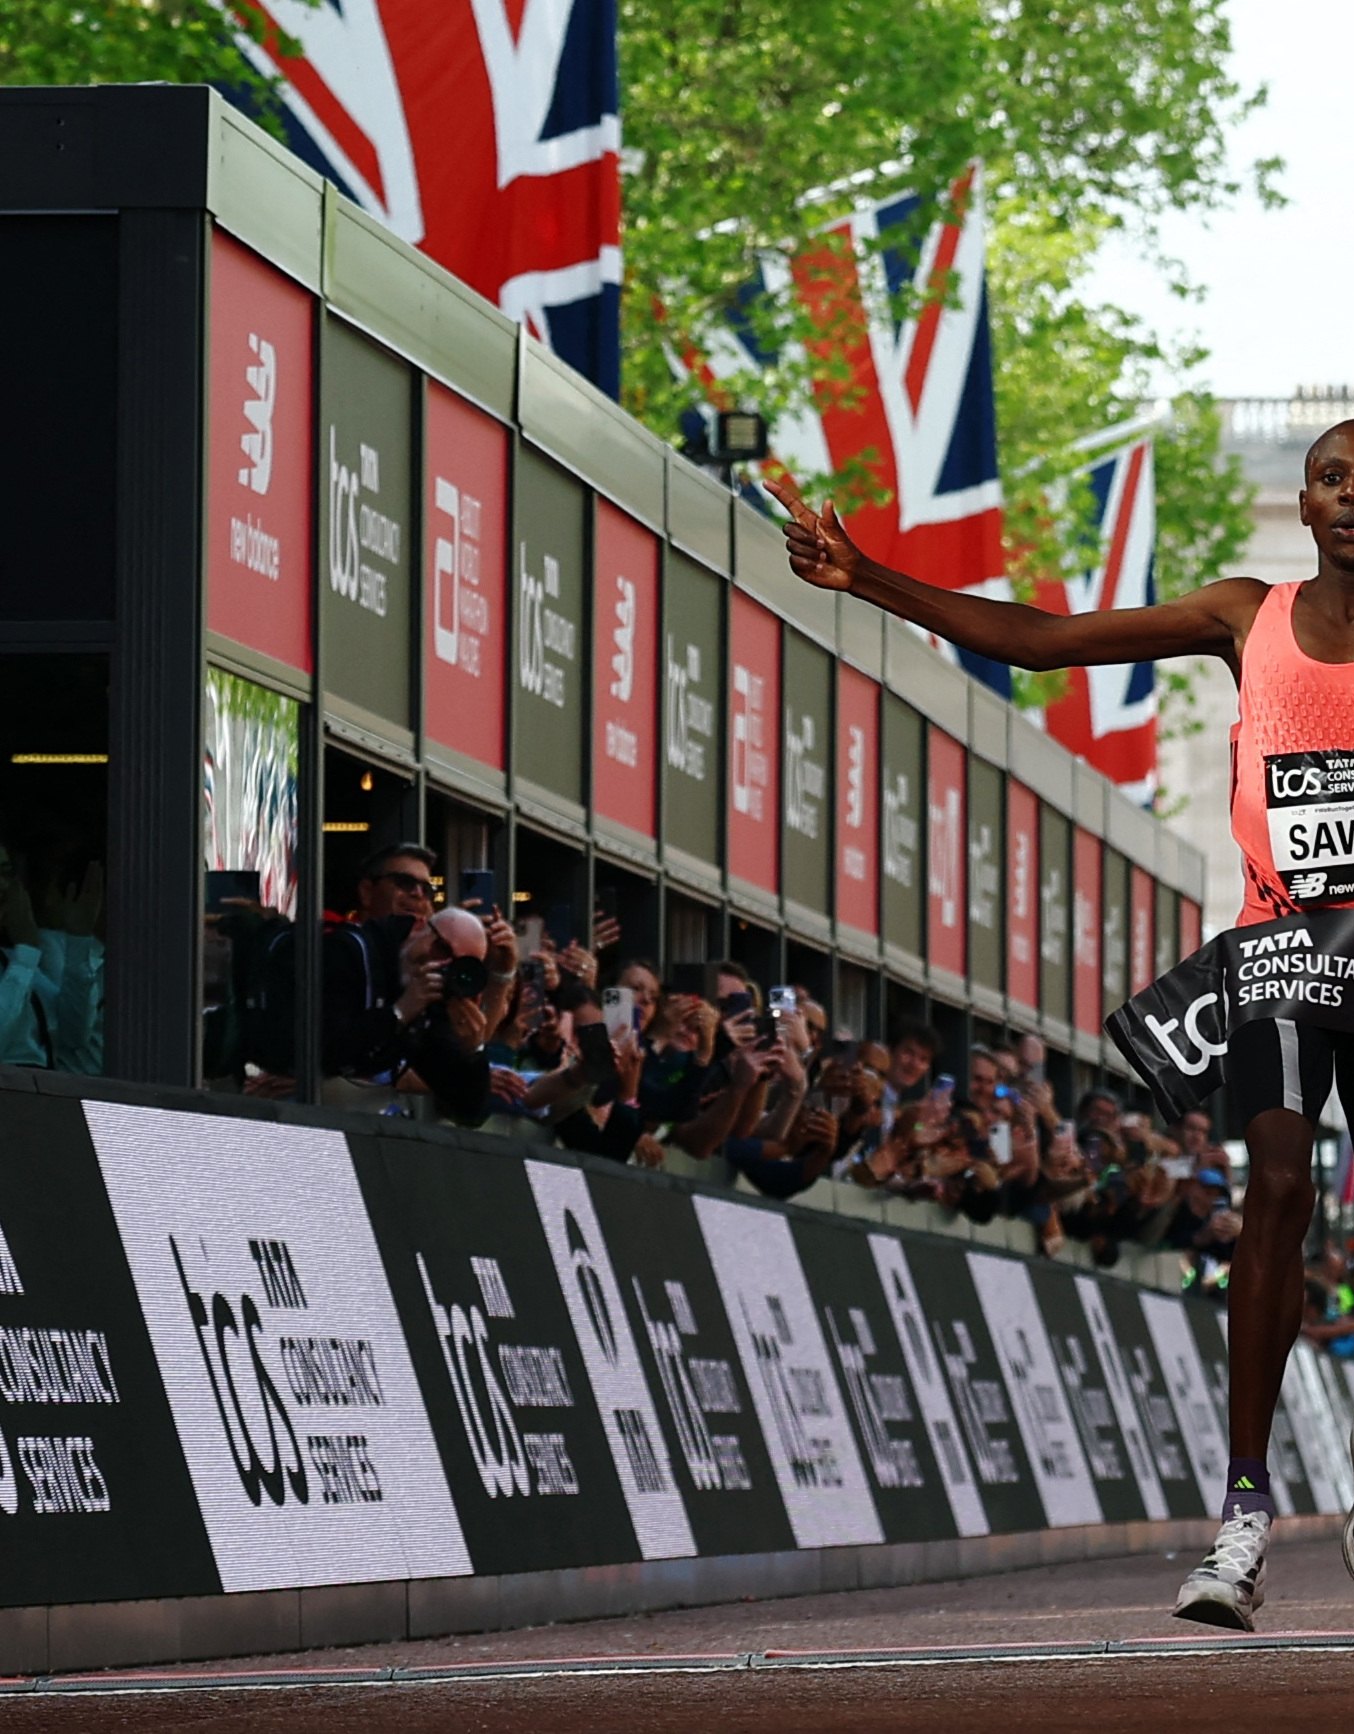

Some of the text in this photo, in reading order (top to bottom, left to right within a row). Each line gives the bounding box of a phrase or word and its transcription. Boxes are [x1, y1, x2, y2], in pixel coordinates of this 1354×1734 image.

[1271, 764, 1322, 799] tcs
[1328, 883, 1354, 896] new
[1239, 928, 1313, 958] TATA
[1238, 979, 1344, 1007] SERVICES
[1144, 990, 1229, 1077] tc
[248, 1239, 308, 1309] TATA
[169, 1233, 310, 1507] tcs
[416, 1250, 531, 1499] tcs
[17, 1436, 111, 1514] SERVICES
